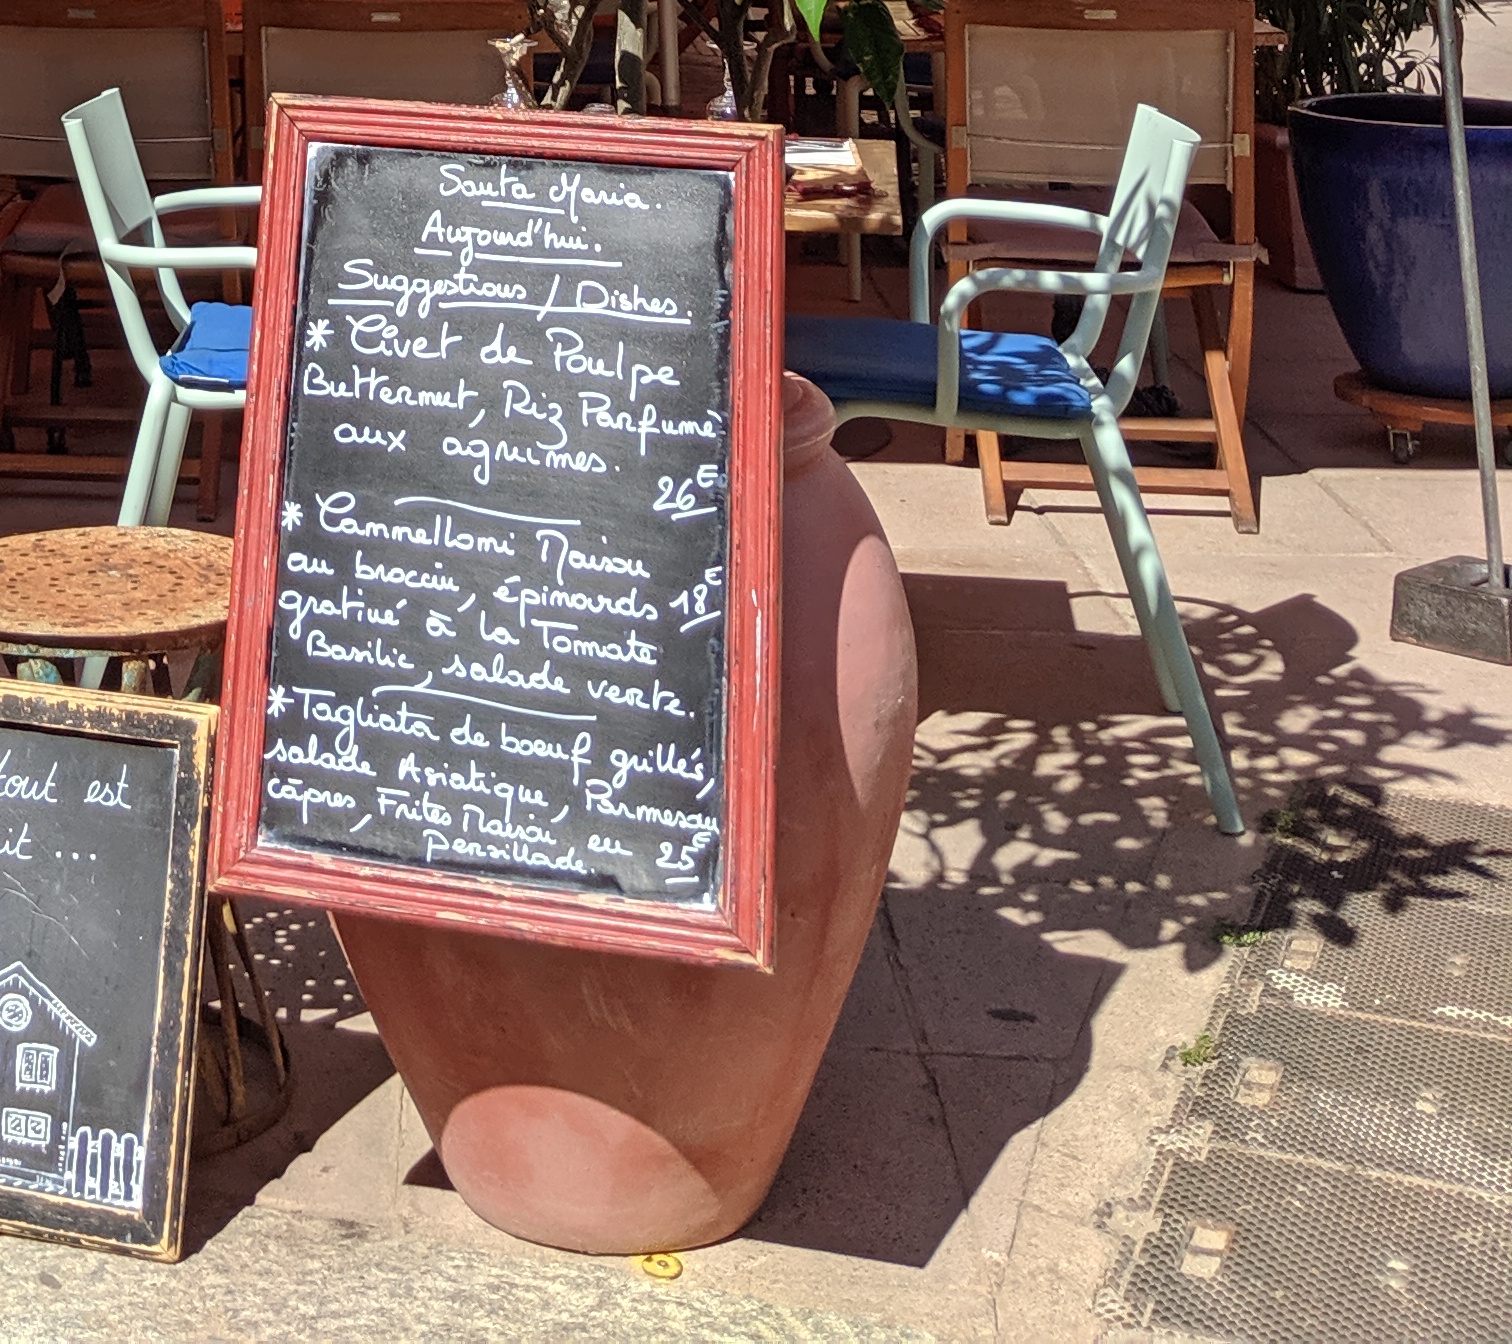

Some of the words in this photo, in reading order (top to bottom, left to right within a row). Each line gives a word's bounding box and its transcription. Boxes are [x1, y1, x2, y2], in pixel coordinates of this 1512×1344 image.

[439, 163, 536, 201] Santa
[337, 258, 528, 319] Suggestions
[346, 314, 464, 360] Civet
[479, 322, 535, 367] de
[545, 327, 682, 402] Poulpe
[332, 422, 407, 453] aux
[502, 379, 569, 450] Riz
[315, 490, 518, 558] Cannelloni
[536, 528, 652, 587] Maison
[278, 584, 409, 640] gratiné
[424, 610, 458, 640] à
[479, 610, 521, 647] la
[530, 617, 659, 667] Tomate
[285, 551, 336, 577] au
[492, 574, 660, 629] épinards
[441, 652, 572, 695] salade
[297, 686, 442, 757] Tagliata
[448, 714, 492, 750] de
[499, 721, 594, 786] boeuf
[82, 763, 133, 810] est
[262, 736, 378, 778] salade
[584, 778, 720, 834] Parmesan
[376, 784, 454, 828] Frites
[462, 804, 559, 848] Maison
[587, 831, 634, 857] en
